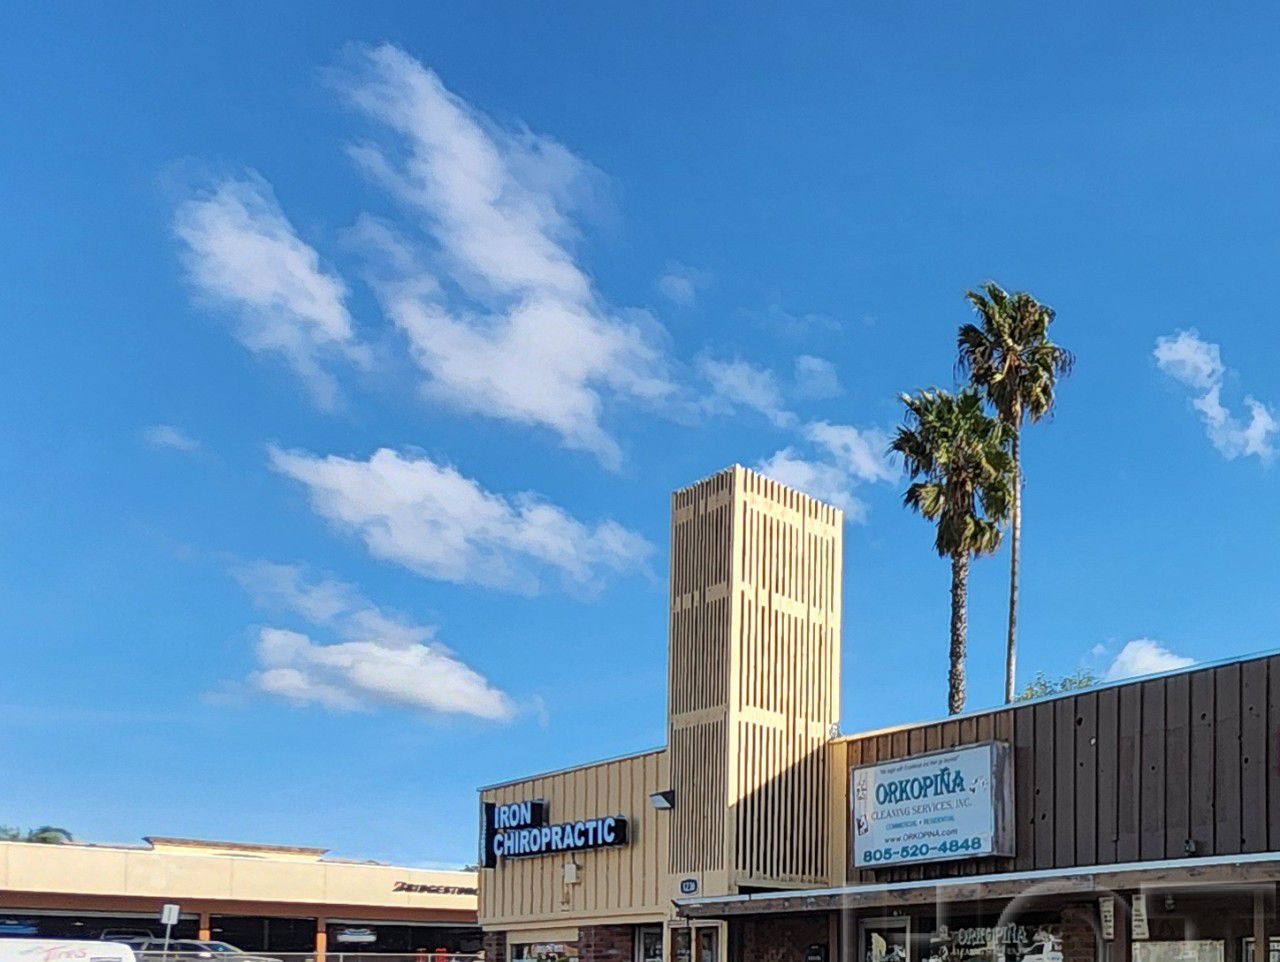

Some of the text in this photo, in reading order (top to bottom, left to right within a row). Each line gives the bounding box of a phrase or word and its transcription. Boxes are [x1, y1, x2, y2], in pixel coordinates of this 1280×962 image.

[875, 766, 966, 805] ORKOPIÑA
[494, 801, 532, 829] IRON
[871, 805, 910, 821] CLEANING
[911, 800, 953, 817] SERVICES,
[493, 817, 616, 856] CHIROPRACTIC
[863, 837, 982, 862] 805-520-4848
